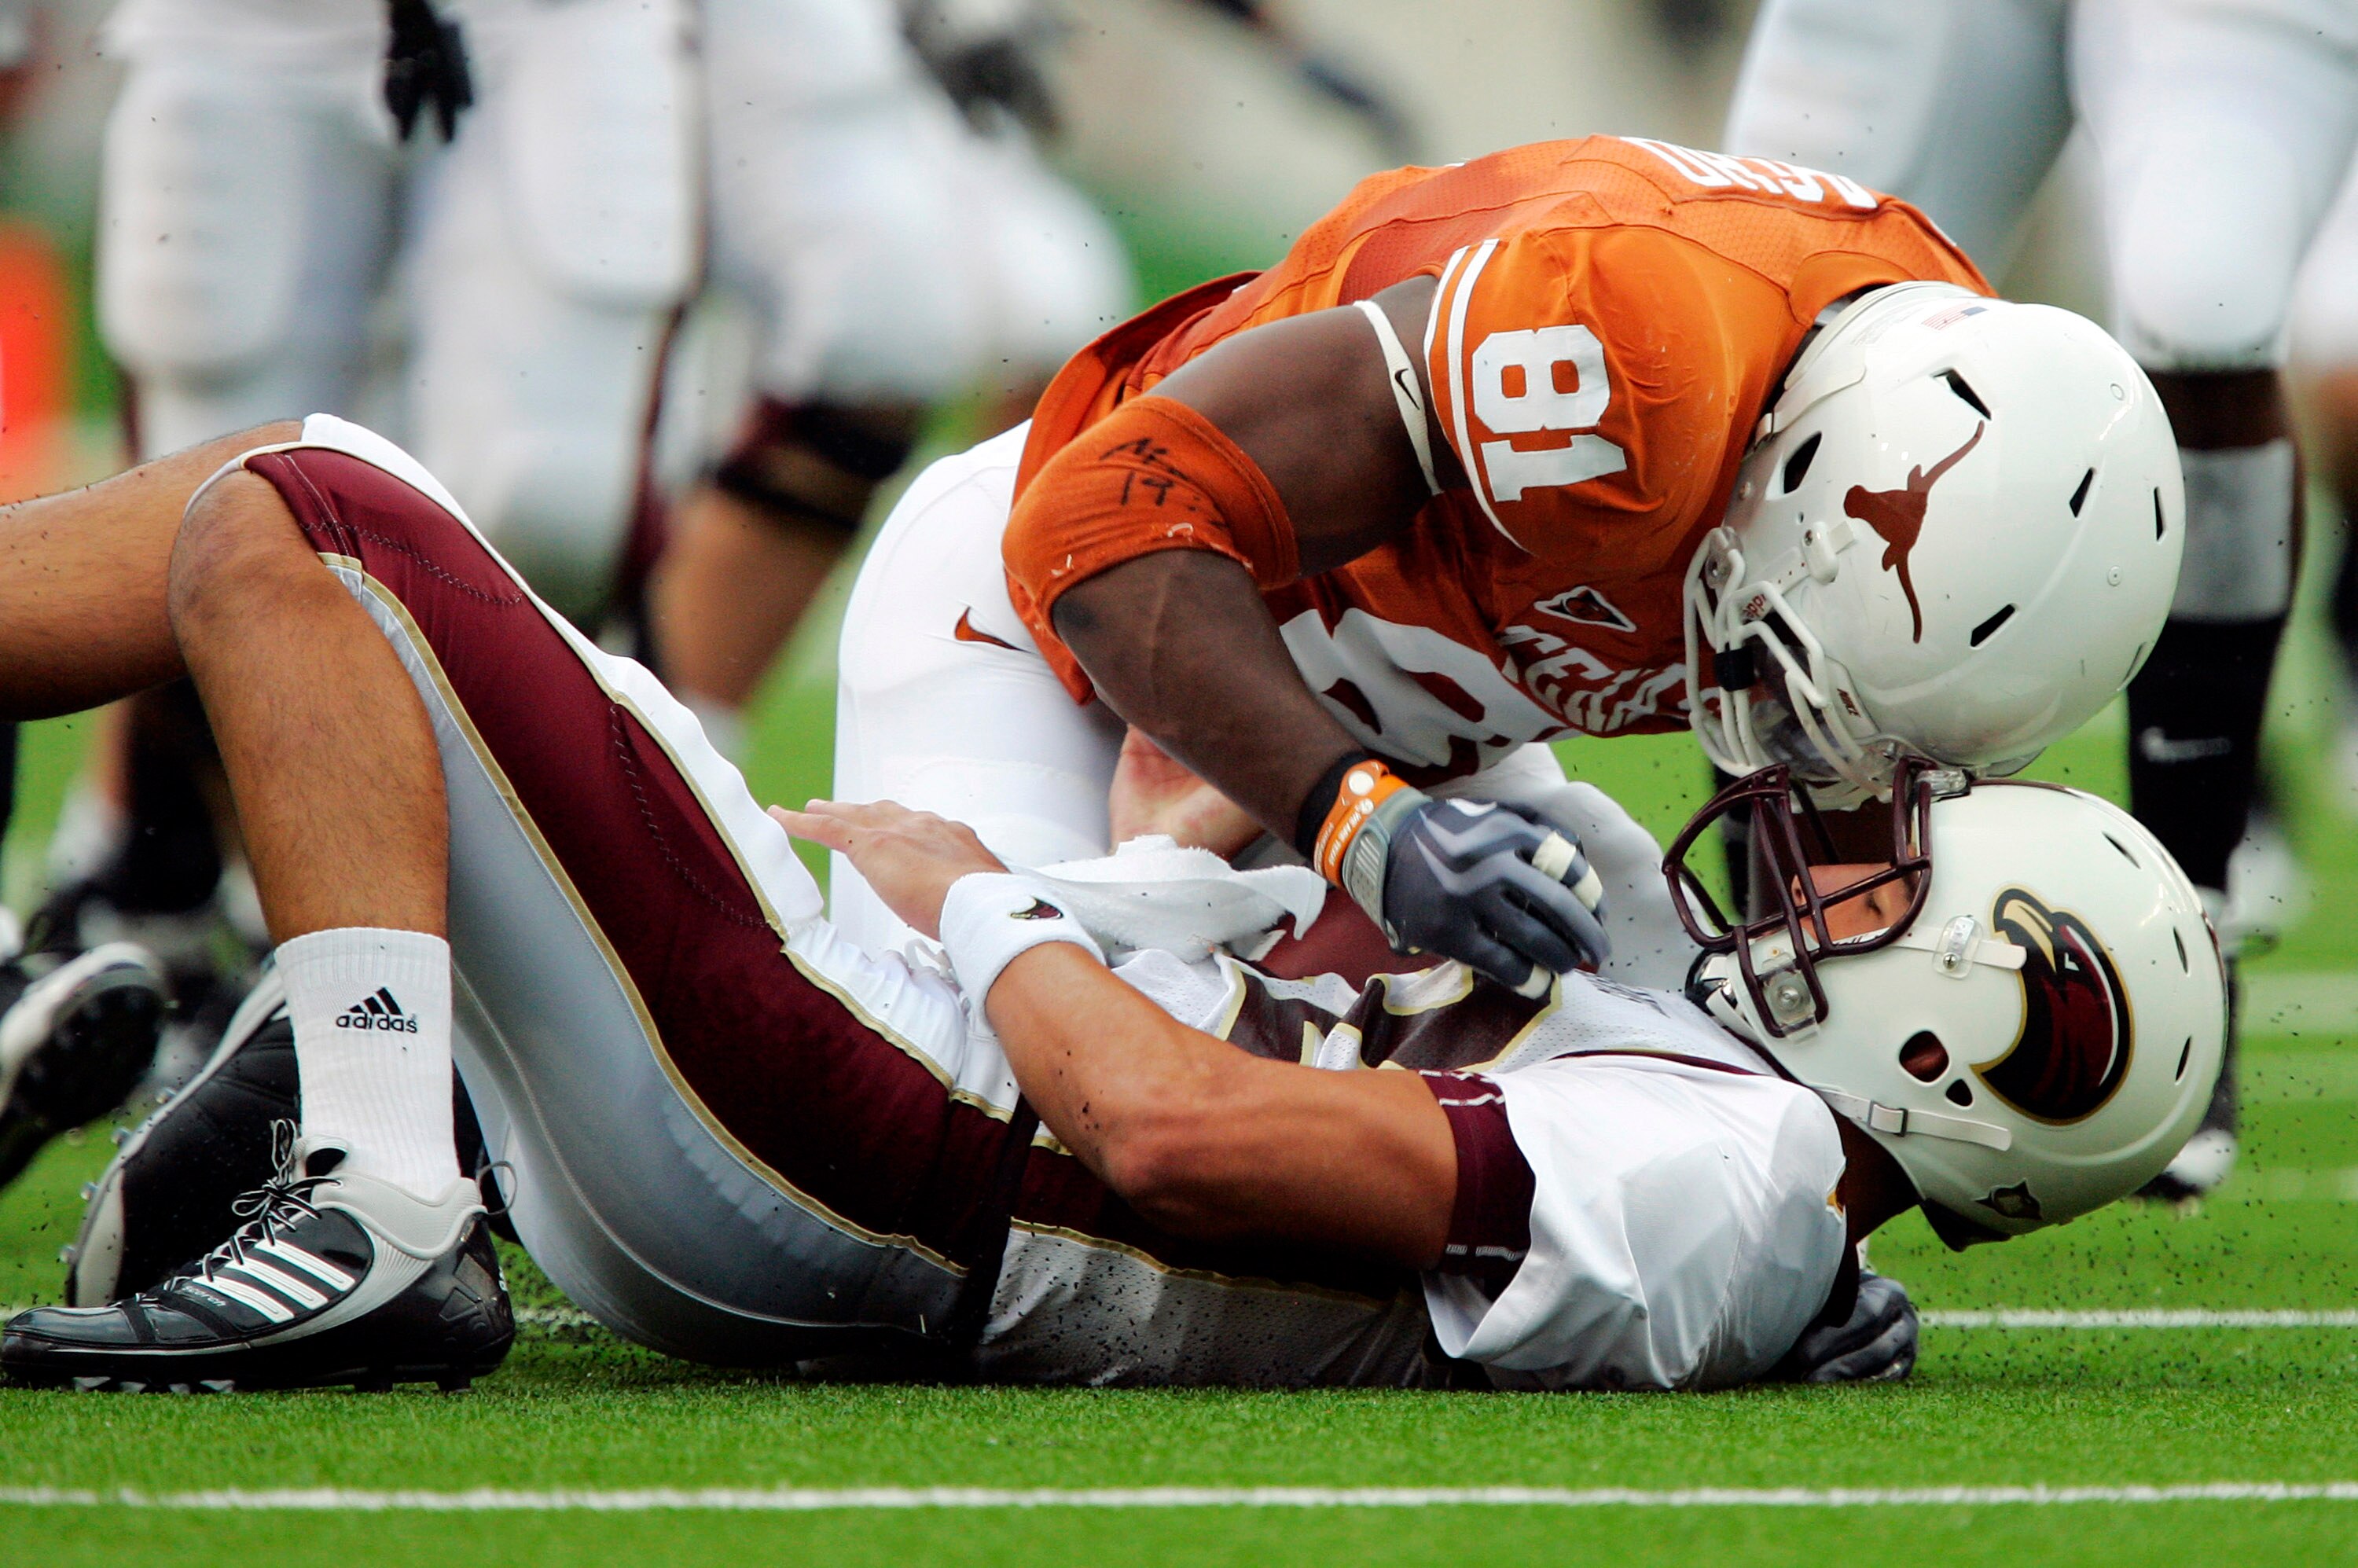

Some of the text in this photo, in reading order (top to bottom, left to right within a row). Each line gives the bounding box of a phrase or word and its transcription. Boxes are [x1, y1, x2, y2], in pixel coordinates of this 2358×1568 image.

[1472, 324, 1628, 503] 81
[1279, 607, 1572, 777] 8
[336, 1012, 418, 1034] adidas
